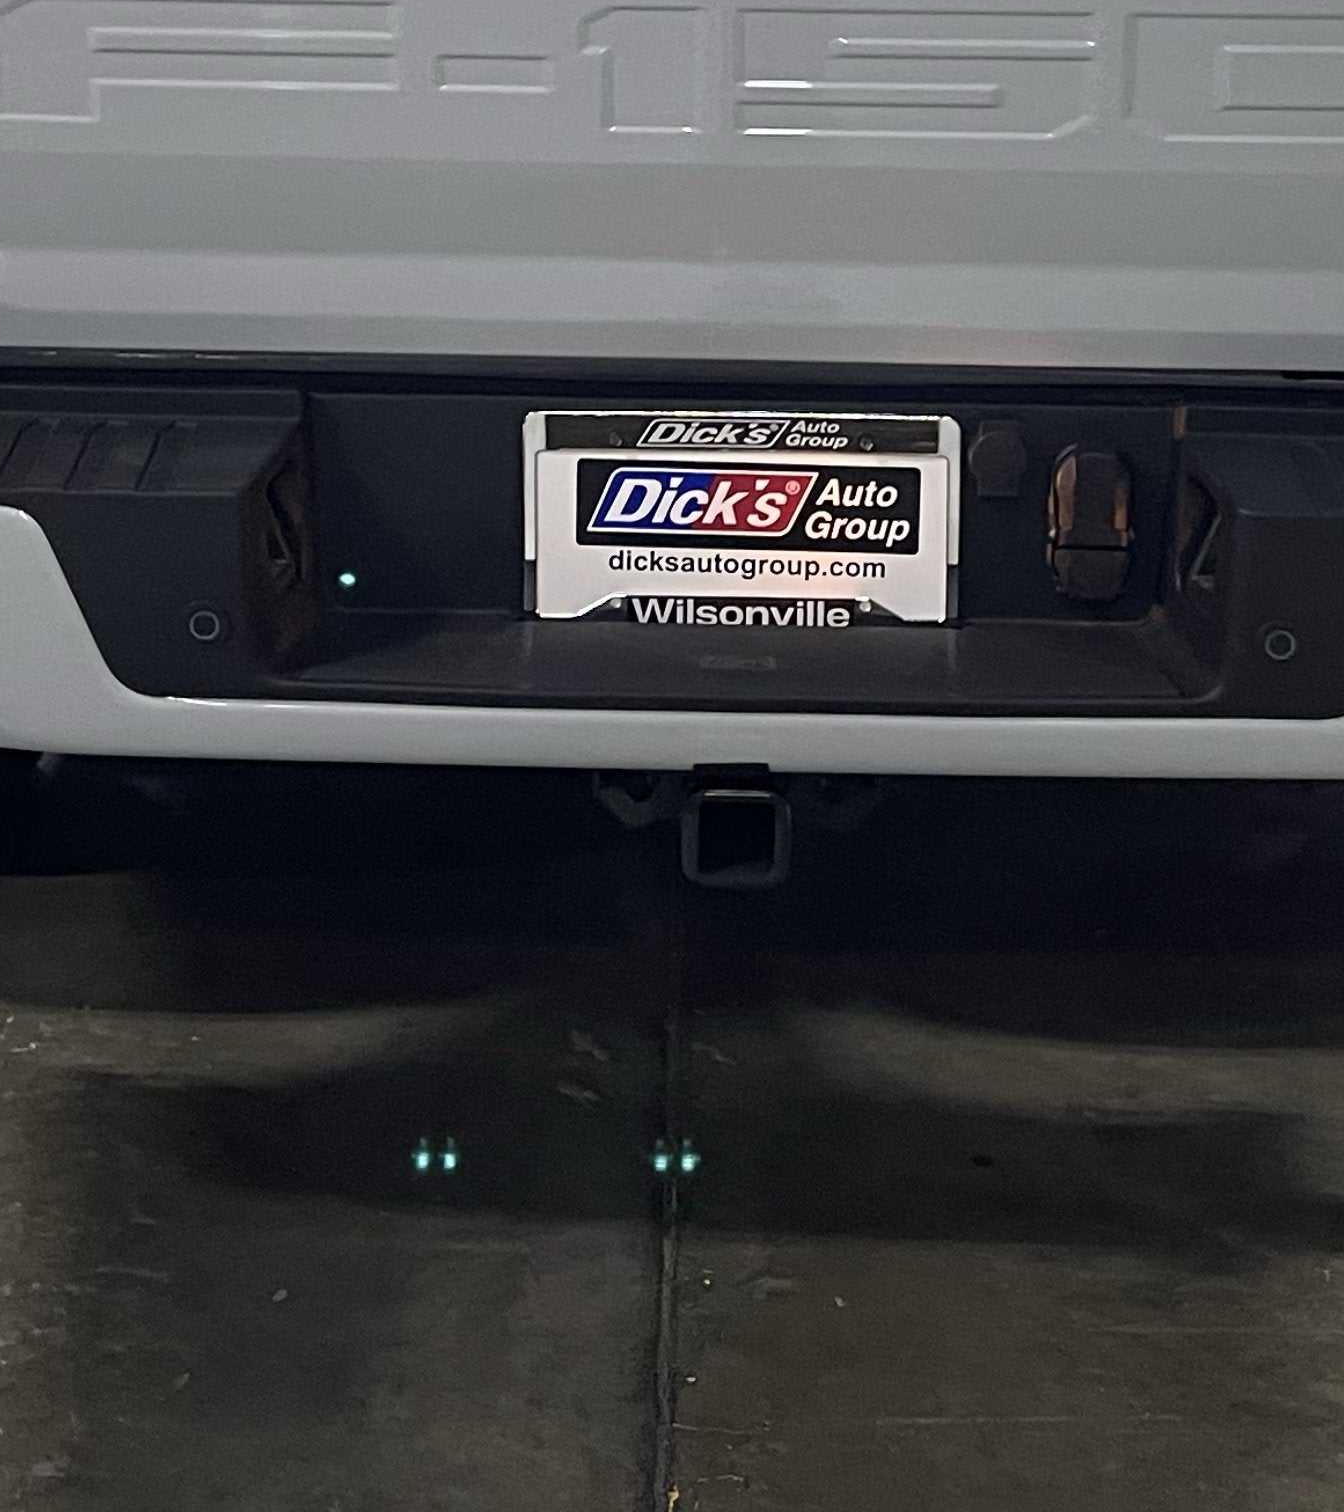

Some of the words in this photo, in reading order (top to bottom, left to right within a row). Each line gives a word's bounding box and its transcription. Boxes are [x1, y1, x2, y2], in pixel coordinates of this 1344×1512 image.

[785, 433, 850, 451] Group
[790, 420, 841, 434] Auto
[816, 478, 899, 508] Auto
[805, 510, 911, 547] Group
[608, 550, 887, 580] dicksautogroup.com
[631, 597, 851, 628] Wilsonville
